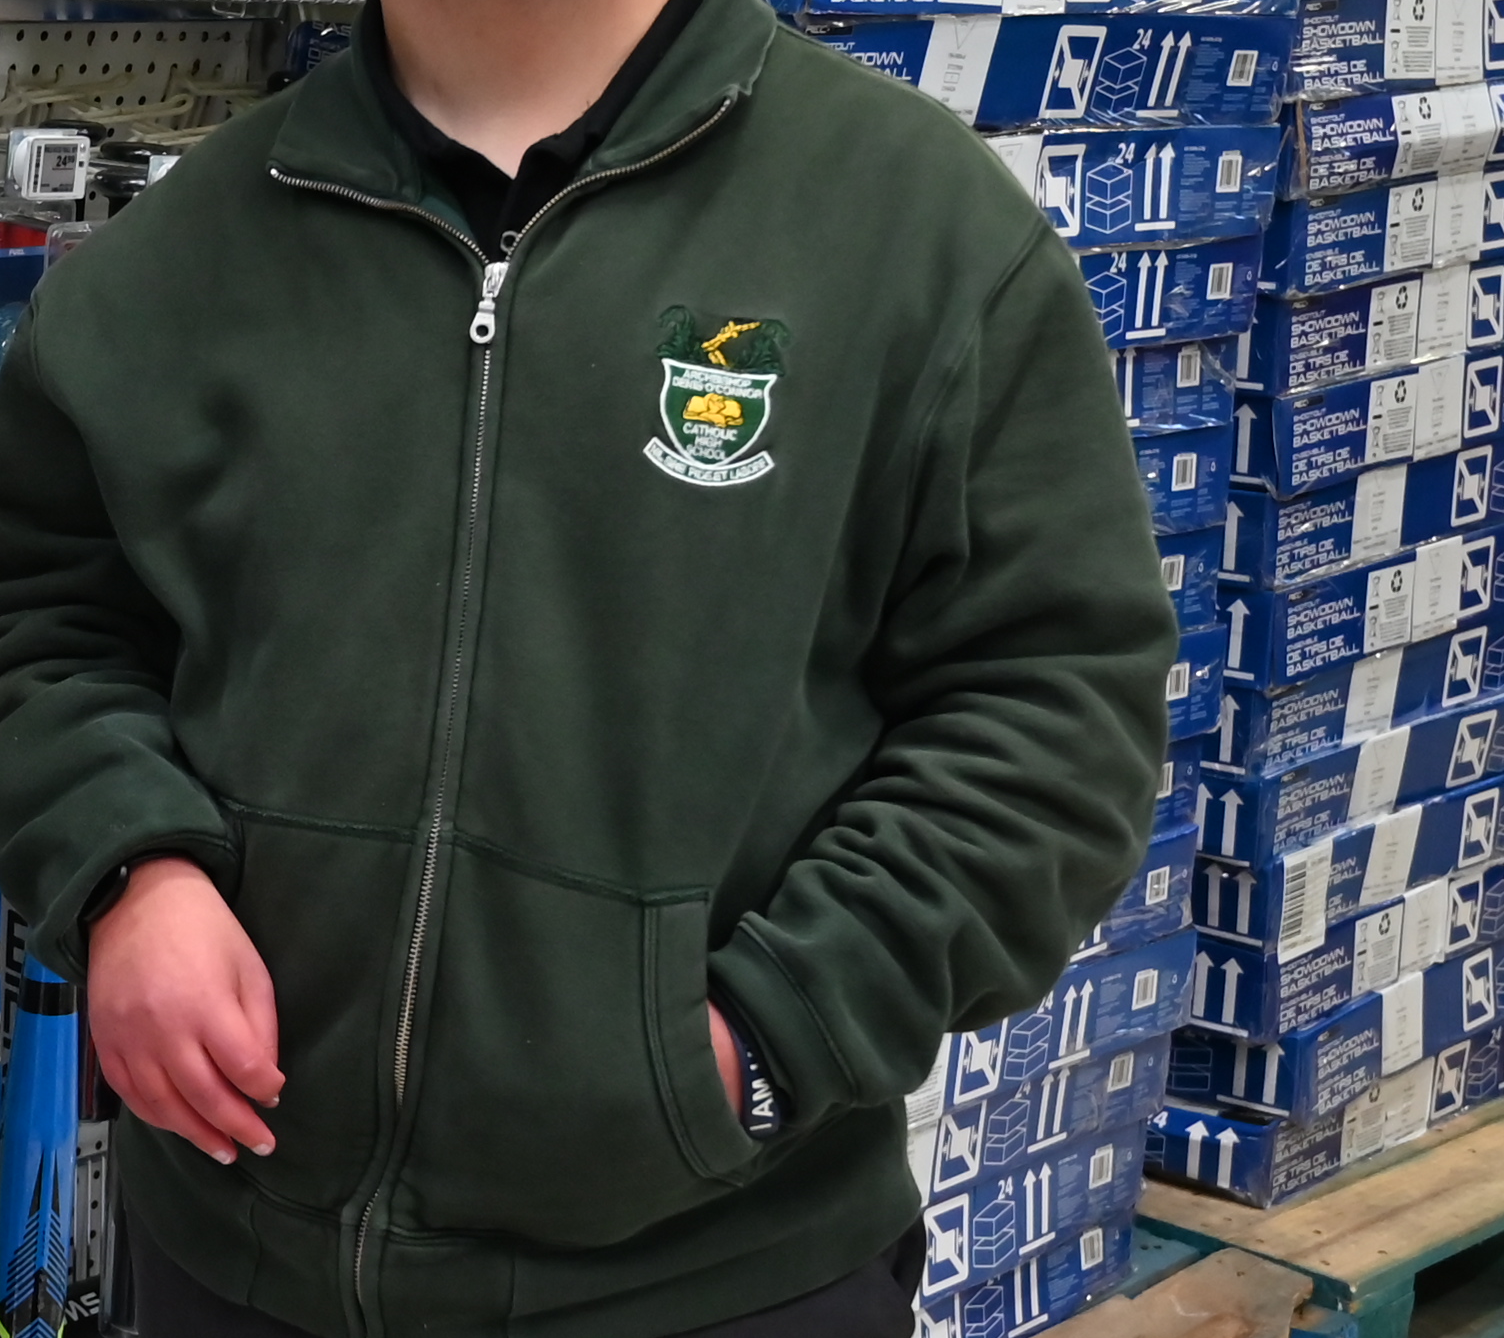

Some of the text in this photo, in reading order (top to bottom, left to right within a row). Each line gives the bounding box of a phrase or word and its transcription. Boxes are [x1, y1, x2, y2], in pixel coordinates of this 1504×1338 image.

[1302, 19, 1377, 39] SHOWDOWN
[1302, 32, 1384, 52] BASKETBALL
[1303, 72, 1386, 91] BASKETBALL
[682, 367, 752, 388] ARCHBISHOP
[682, 421, 738, 442] CATHOLIC
[685, 444, 727, 462] SCHOOL
[751, 1076, 775, 1118] AM
